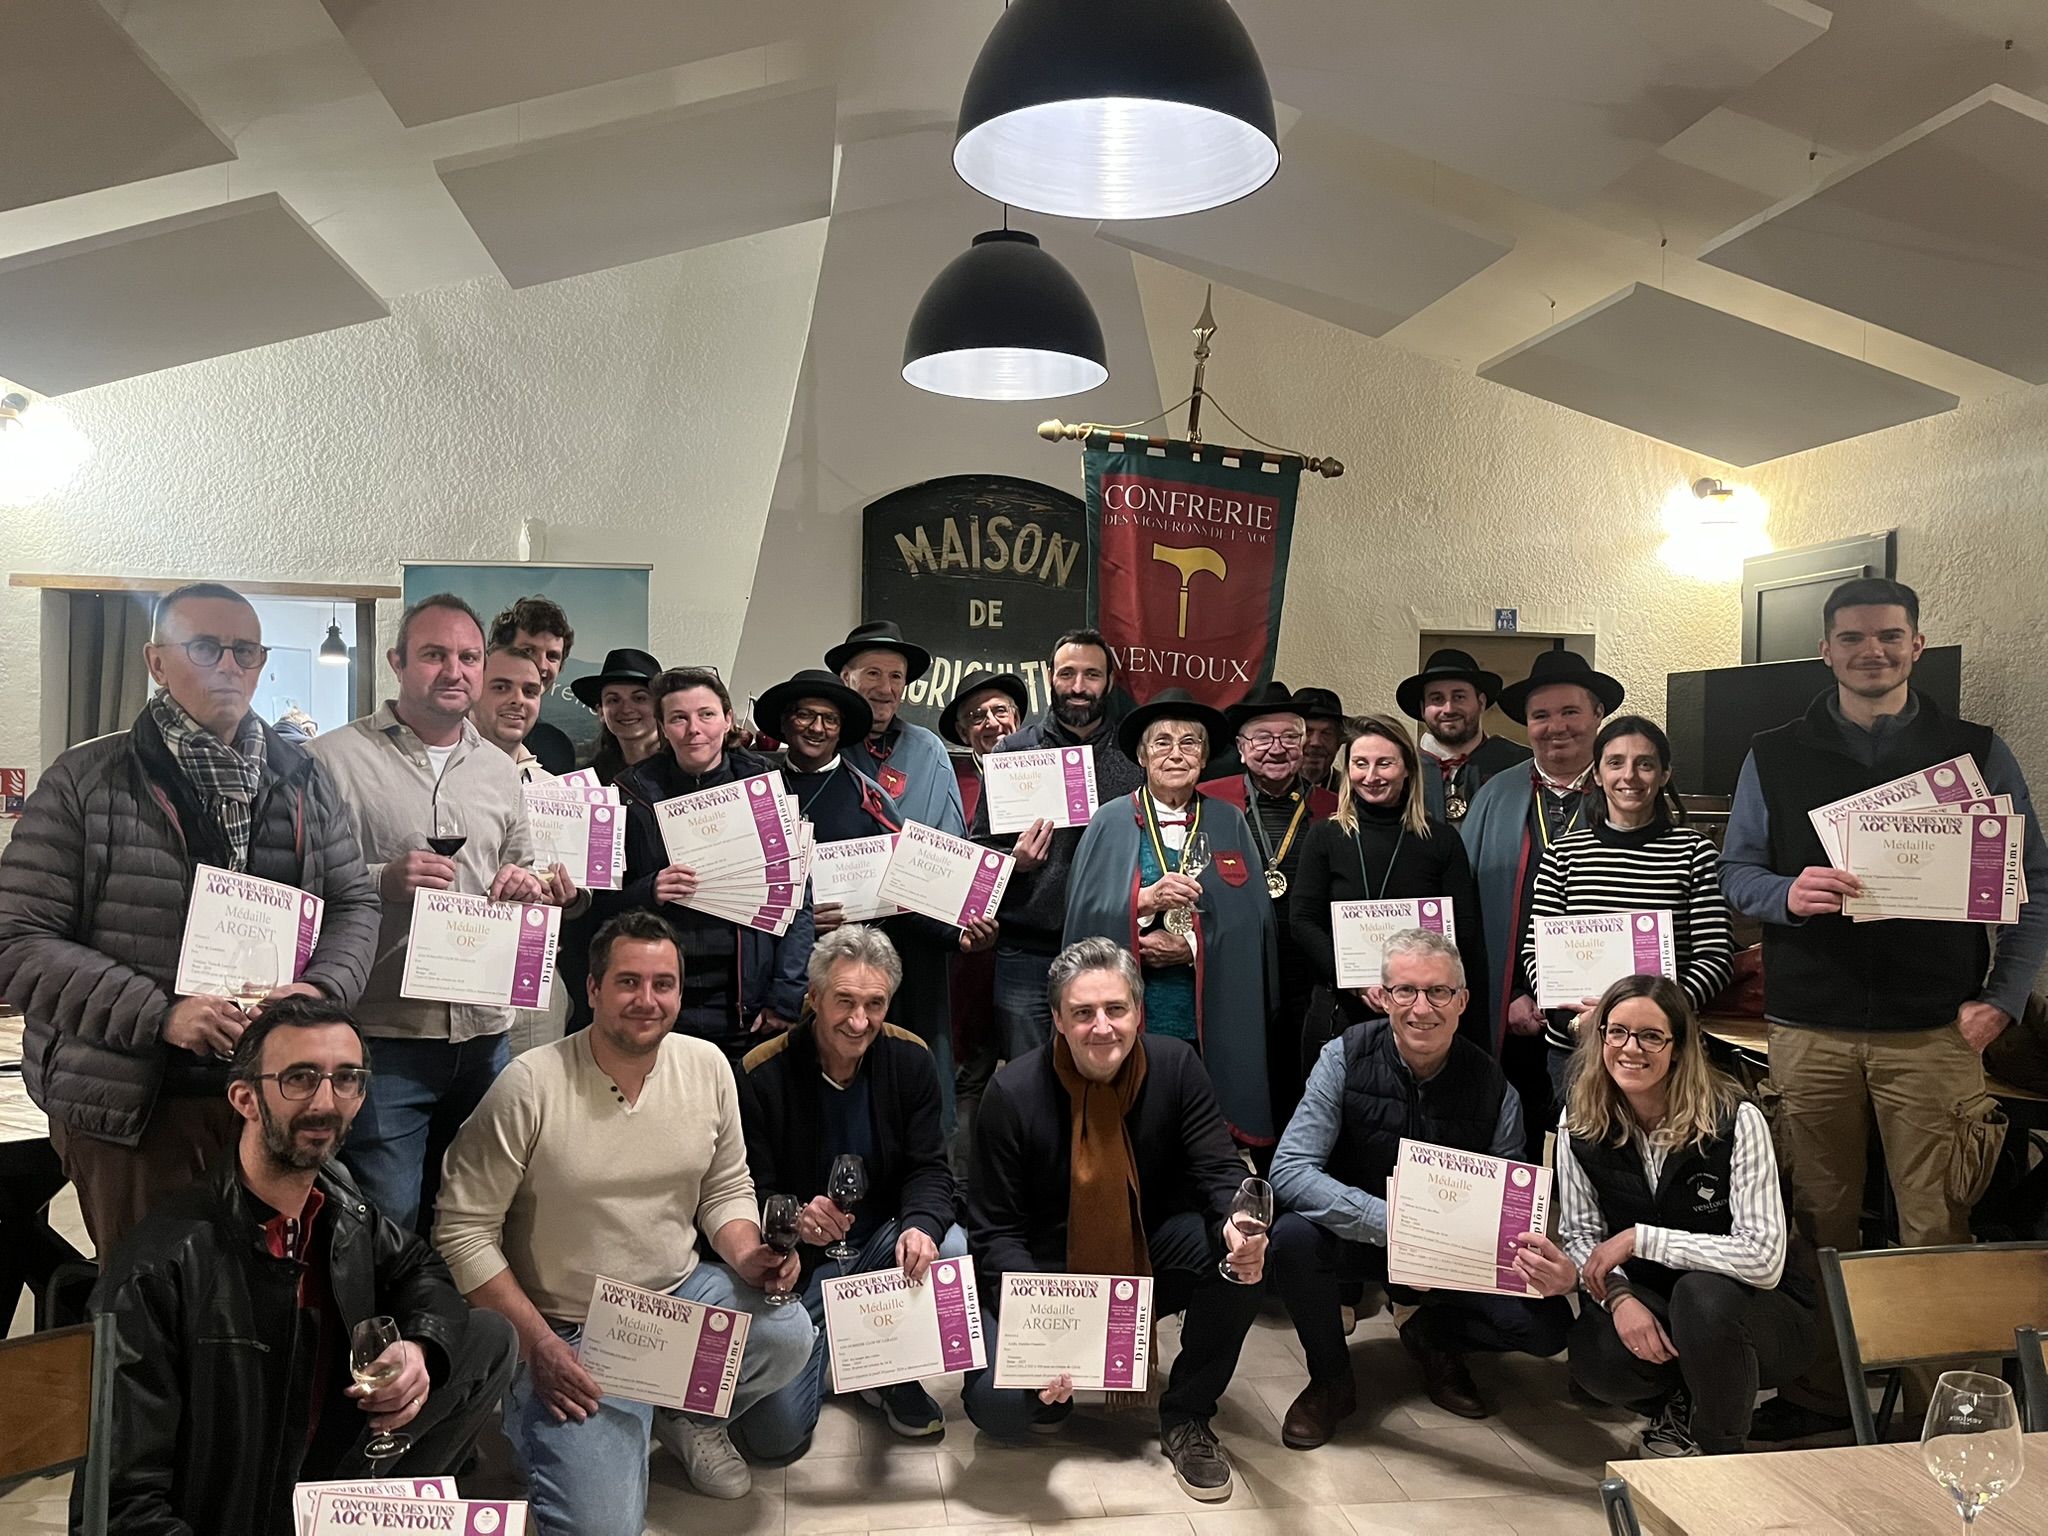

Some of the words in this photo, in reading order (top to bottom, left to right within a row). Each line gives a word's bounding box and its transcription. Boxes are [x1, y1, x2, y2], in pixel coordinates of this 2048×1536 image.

[1104, 484, 1273, 530] CONFRERIE
[1104, 514, 1129, 526] DES
[1133, 514, 1208, 536] VIGNERONS
[1210, 527, 1228, 541] DE
[894, 515, 1081, 589] MAISON
[968, 599, 1003, 628] DE
[1109, 646, 1250, 684] VENTOUX
[993, 762, 1012, 770] AOC
[1014, 758, 1056, 768] VENTOUX
[1009, 771, 1042, 781] Médaille
[1019, 782, 1034, 790] OR
[664, 798, 704, 811] CONCOURS
[706, 792, 720, 801] DES
[720, 786, 739, 796] VINS
[668, 807, 689, 818] AOC
[692, 792, 740, 812] VENTOUX
[1822, 795, 1872, 818] CONCOURS
[1874, 787, 1894, 801] DES
[1894, 779, 1918, 793] VINS
[535, 806, 582, 819] VENTOUX
[688, 810, 726, 827] Médaille
[776, 793, 792, 836] Diplôme
[1859, 815, 1915, 824] CONCOURS
[1917, 816, 1937, 824] DES
[1939, 817, 1963, 825] VINS
[536, 830, 552, 840] OR
[701, 826, 719, 836] OR
[1860, 822, 1890, 832] AOC
[1894, 823, 1962, 835] VENTOUX
[613, 827, 623, 868] Diplôme
[816, 844, 855, 854] CONCOURS
[857, 842, 868, 851] DES
[869, 839, 885, 848] VINS
[907, 833, 929, 844] AOC
[930, 838, 972, 860] VENTOUX
[909, 825, 948, 844] CONCOURS
[948, 838, 963, 848] DES
[961, 842, 976, 853] VINS
[1883, 839, 1935, 851] Médaille
[818, 851, 839, 861] AOC
[841, 845, 886, 858] VENTOUX
[917, 848, 952, 866] Médaille
[1897, 853, 1919, 864] OR
[835, 860, 870, 872] Médaille
[908, 856, 954, 878] ARGENT
[2005, 843, 2018, 896] Diplôme
[832, 869, 877, 884] BRONZE
[207, 873, 257, 891] CONCOURS
[259, 884, 274, 894] DES
[276, 888, 293, 900] VINS
[985, 874, 1005, 915] Diplôme
[206, 882, 235, 897] AOC
[238, 888, 292, 911] VENTOUX
[428, 894, 475, 906] CONCOURS
[225, 905, 271, 925] Médaille
[427, 902, 454, 913] AOC
[457, 905, 512, 921] VENTOUX
[1341, 904, 1379, 912] CONCOURS
[1342, 911, 1363, 919] AOC
[1365, 909, 1412, 918] VENTOUX
[215, 920, 276, 942] ARGENT
[447, 920, 490, 935] Médaille
[1360, 922, 1395, 931] Médaille
[1544, 919, 1586, 927] CONCOURS
[1588, 918, 1603, 926] DES
[1545, 926, 1568, 936] AOC
[1570, 923, 1624, 934] VENTOUX
[456, 936, 476, 948] OR
[1370, 933, 1385, 943] OR
[1564, 939, 1605, 949] Médaille
[542, 932, 556, 983] Diplôme
[1576, 951, 1594, 961] OR
[1410, 1145, 1457, 1163] CONCOURS
[1459, 1155, 1476, 1166] DES
[1477, 1159, 1498, 1170] VINS
[1410, 1154, 1436, 1166] AOC
[1439, 1158, 1497, 1180] VENTOUX
[1428, 1173, 1472, 1191] Médaille
[1438, 1189, 1458, 1203] OR
[834, 1276, 883, 1291] CONCOURS
[884, 1273, 900, 1282] DES
[836, 1288, 863, 1301] AOC
[866, 1279, 924, 1296] VENTOUX
[1010, 1278, 1058, 1287] CONCOURS
[1060, 1280, 1077, 1288] DES
[1079, 1280, 1099, 1288] VINS
[602, 1283, 650, 1305] CONCOURS
[652, 1297, 669, 1308] DES
[672, 1302, 693, 1314] VINS
[1010, 1286, 1037, 1296] AOC
[1040, 1287, 1098, 1298] VENTOUX
[600, 1292, 628, 1307] AOC
[631, 1299, 690, 1324] VENTOUX
[859, 1299, 905, 1315] Médaille
[967, 1284, 980, 1339] Diplôme
[1030, 1304, 1075, 1315] Médaille
[616, 1314, 664, 1336] Médaille
[874, 1315, 894, 1328] OR
[1023, 1319, 1081, 1331] ARGENT
[606, 1328, 668, 1351] ARGENT
[1135, 1306, 1147, 1361] Diplôme
[720, 1340, 740, 1391] Diplôme
[364, 1485, 383, 1495] DES
[384, 1484, 406, 1494] VINS
[332, 1499, 398, 1513] CONCOURS
[401, 1503, 425, 1515] DES
[428, 1505, 455, 1517] VINS
[330, 1510, 368, 1526] AOC
[372, 1512, 453, 1530] VENTOUX
